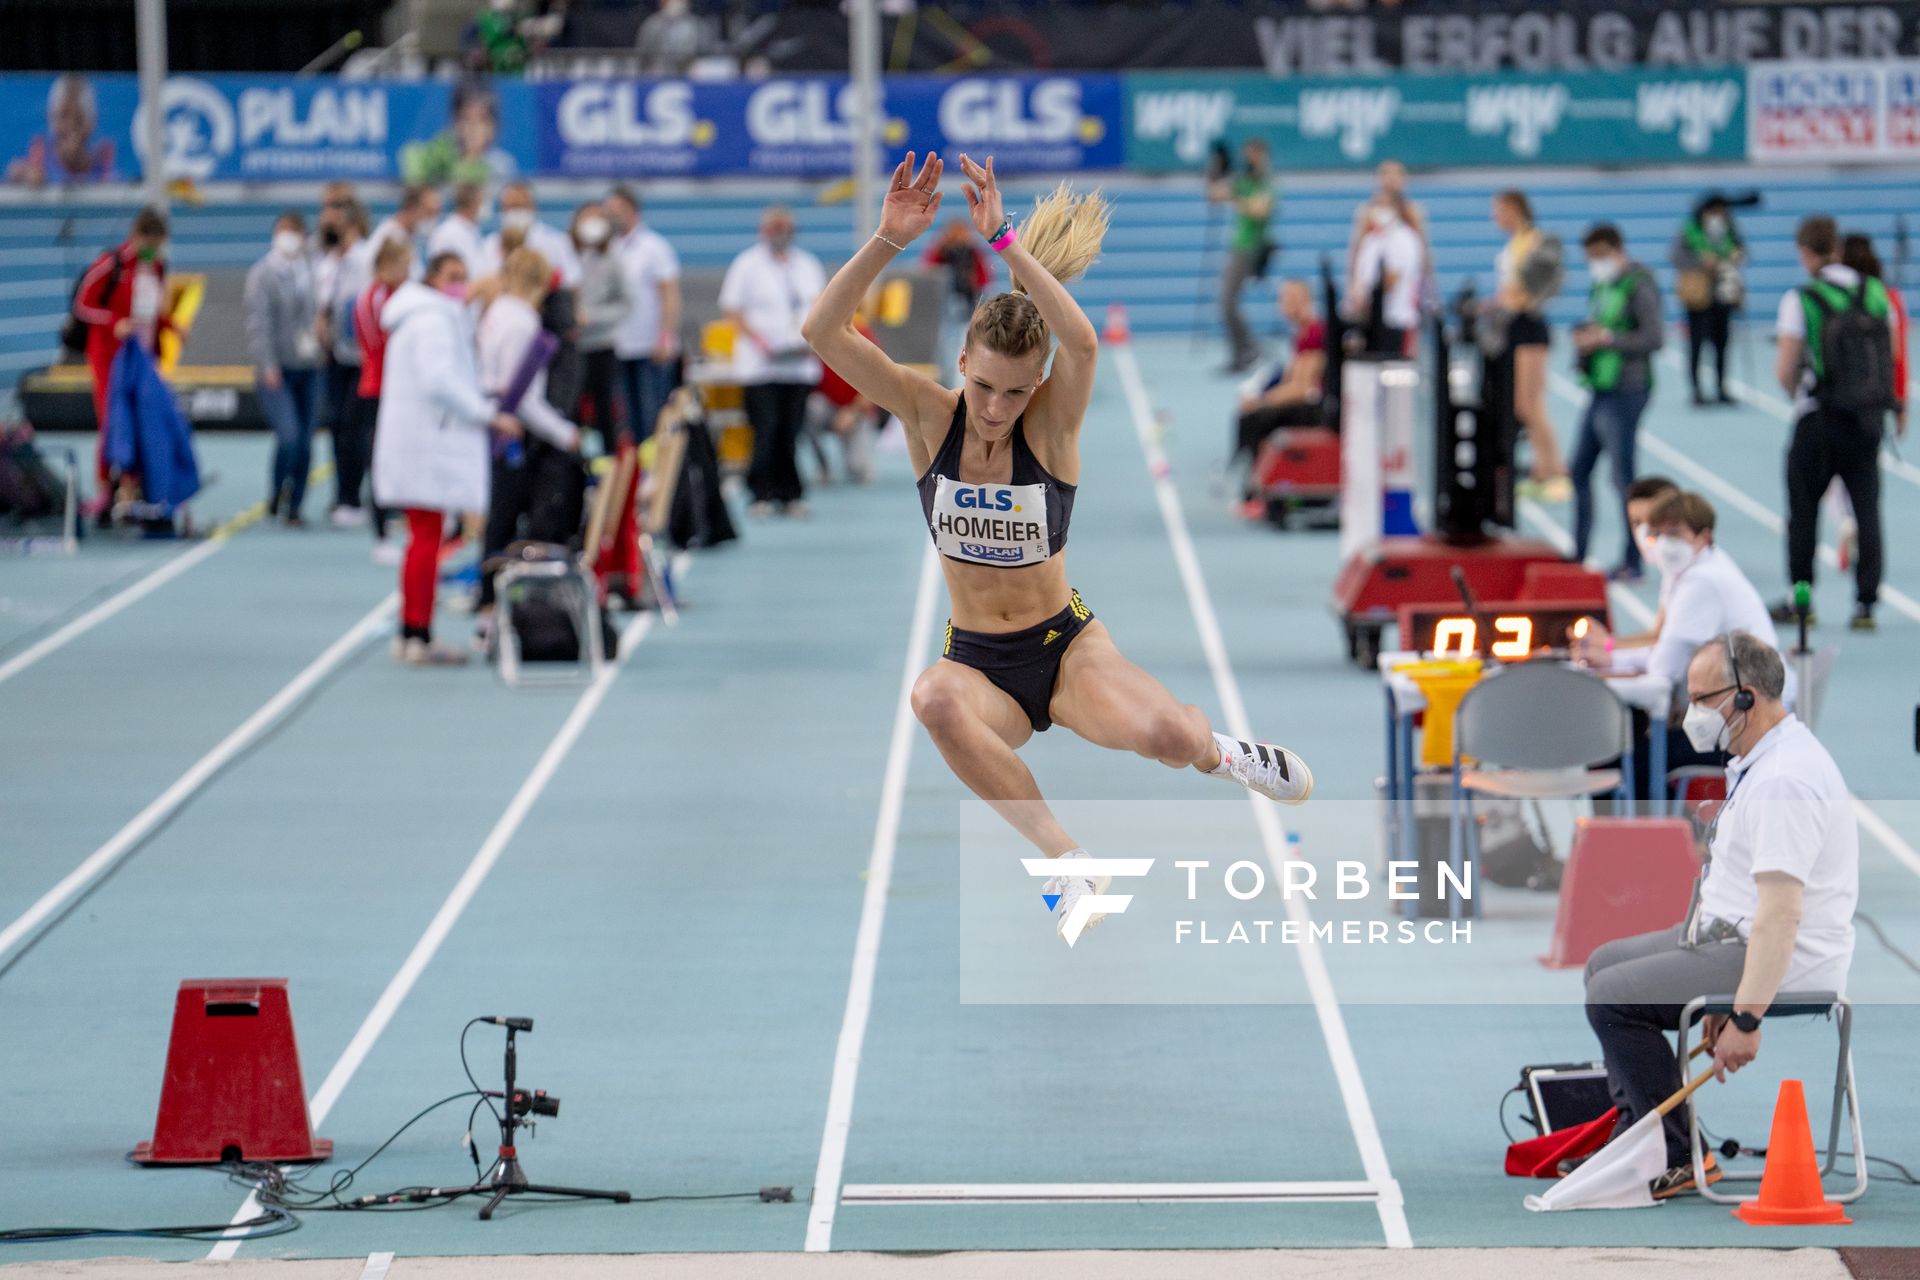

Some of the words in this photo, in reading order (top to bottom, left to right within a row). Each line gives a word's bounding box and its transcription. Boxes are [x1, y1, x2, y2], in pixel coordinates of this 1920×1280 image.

[1256, 16, 1390, 80] VIEL
[1403, 12, 1638, 74] ERFOLG
[1648, 9, 1772, 68] AUF
[1780, 7, 1904, 62] DER
[240, 91, 387, 146] PLAN
[938, 512, 1041, 541] HOMEIER
[986, 546, 1021, 556] PLAN
